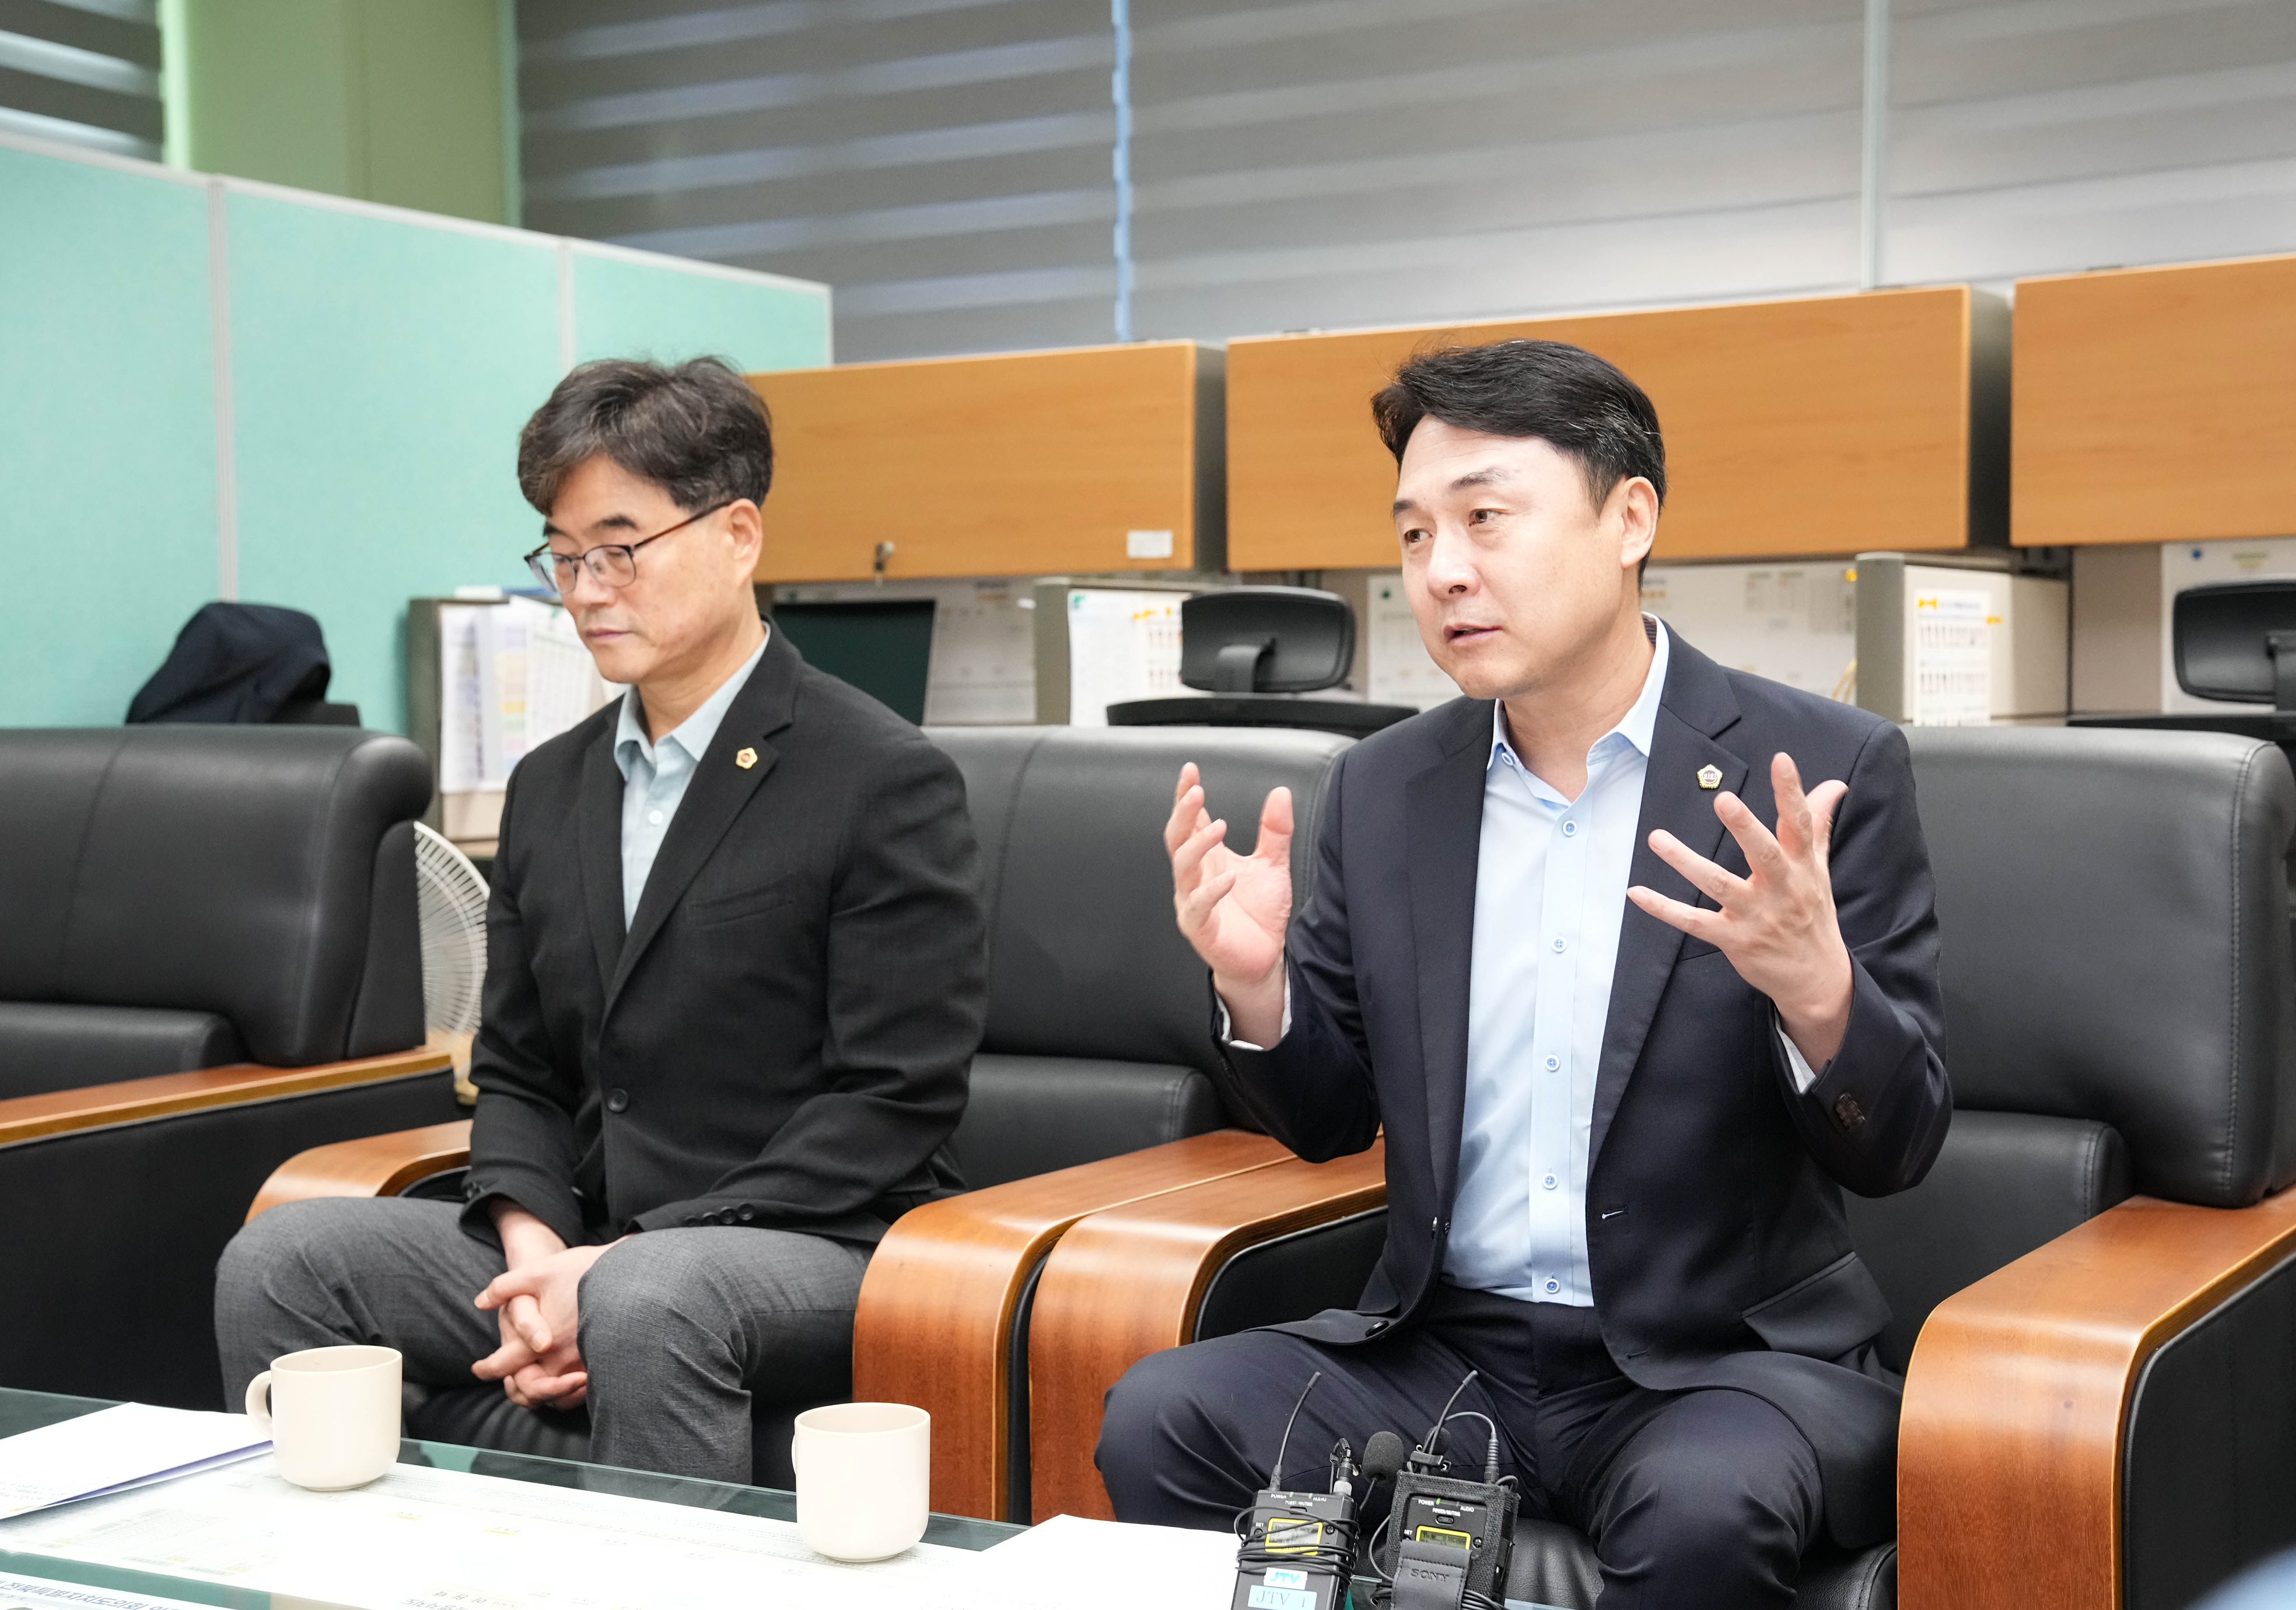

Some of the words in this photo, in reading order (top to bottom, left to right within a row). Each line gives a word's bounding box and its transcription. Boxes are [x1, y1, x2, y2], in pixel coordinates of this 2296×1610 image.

[1432, 1508, 1461, 1517] POWER/MUTING
[1270, 1572, 1300, 1584] JTV
[1410, 1568, 1449, 1582] SONY
[0, 1582, 149, 1610] 전북특별자치도의회
[1256, 1590, 1291, 1606] JTV
